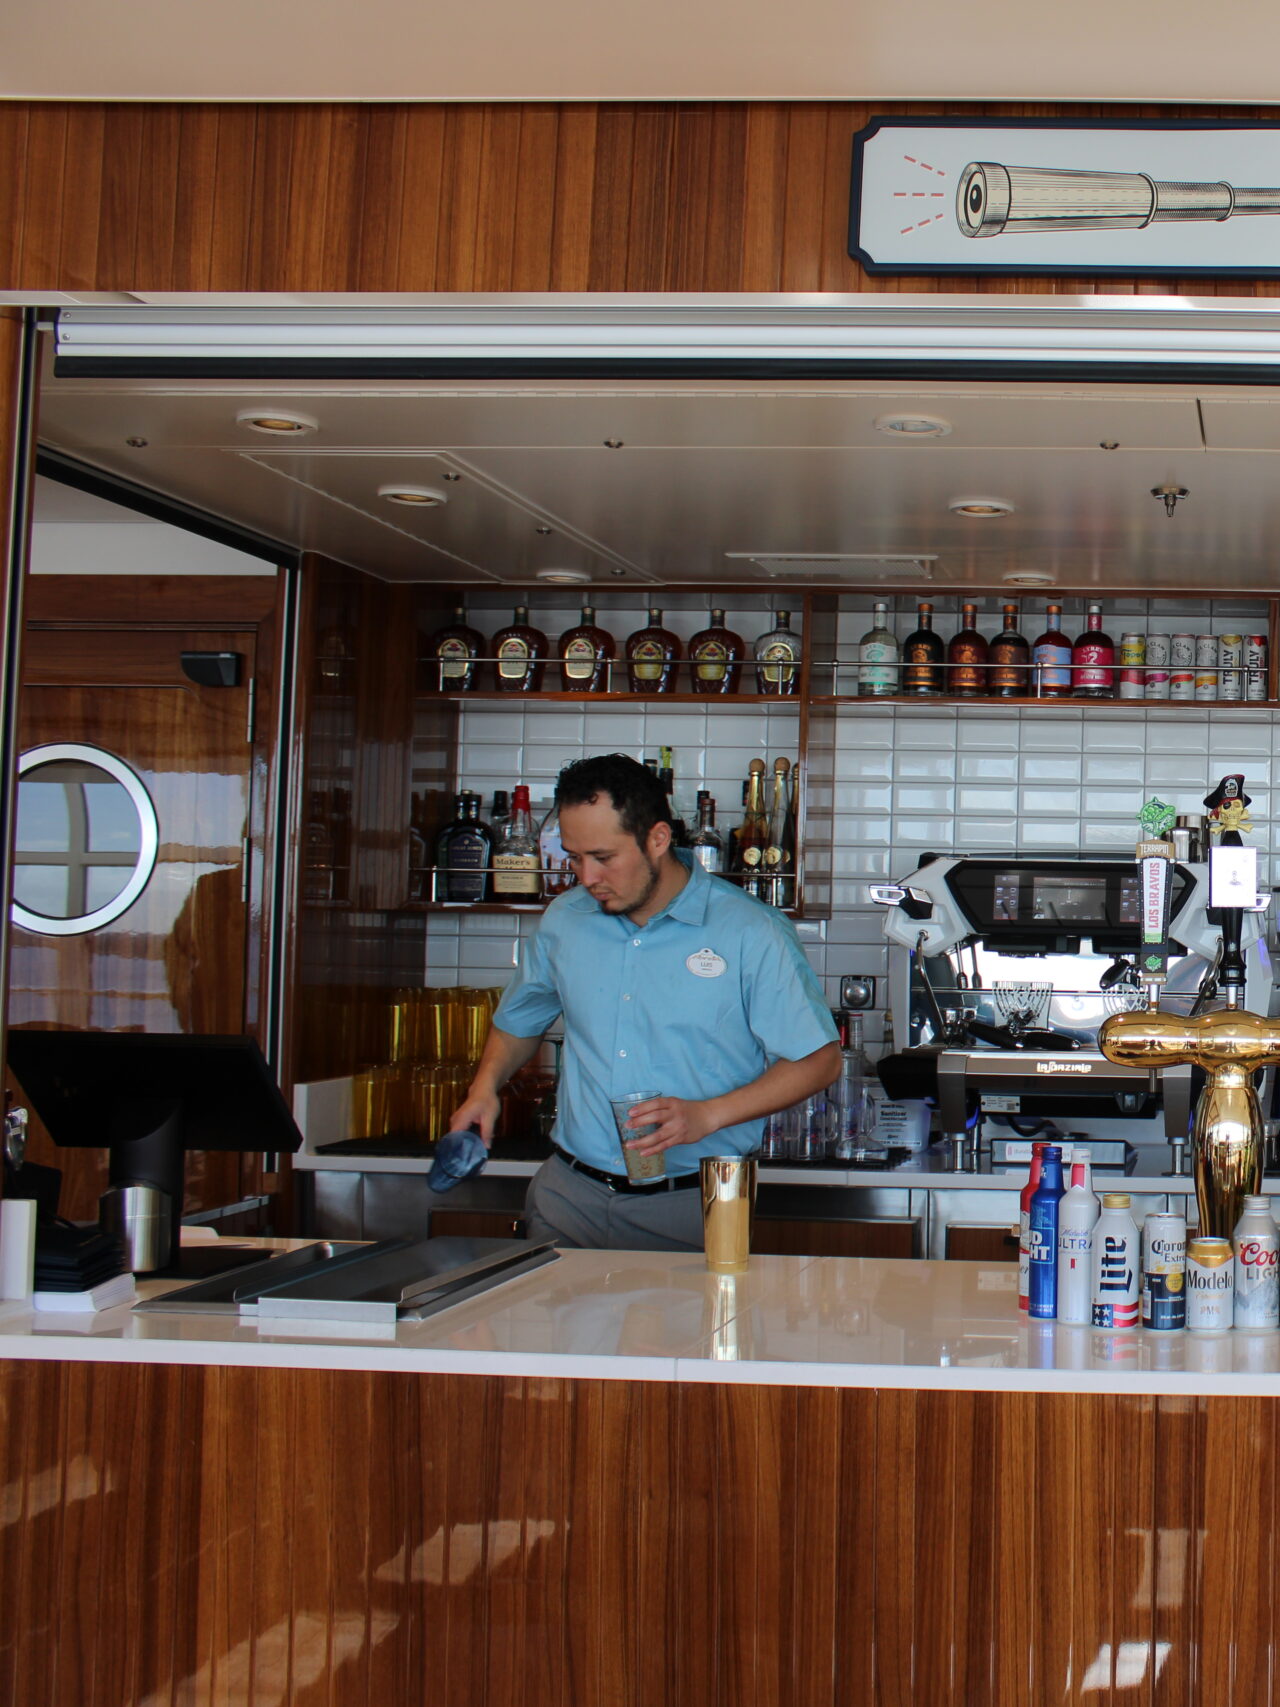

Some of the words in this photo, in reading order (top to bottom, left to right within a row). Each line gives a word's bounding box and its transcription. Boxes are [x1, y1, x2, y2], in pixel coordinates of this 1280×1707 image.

[1223, 650, 1233, 685] TRULY
[1249, 650, 1260, 685] TRULY
[1149, 862, 1160, 906] BRAVOS
[1148, 909, 1159, 928] LOS
[1151, 1240, 1186, 1256] Coron
[1240, 1242, 1280, 1265] Coo
[1100, 1236, 1133, 1294] Lite
[1246, 1268, 1280, 1280] LIGH
[1187, 1269, 1233, 1289] Modelo
